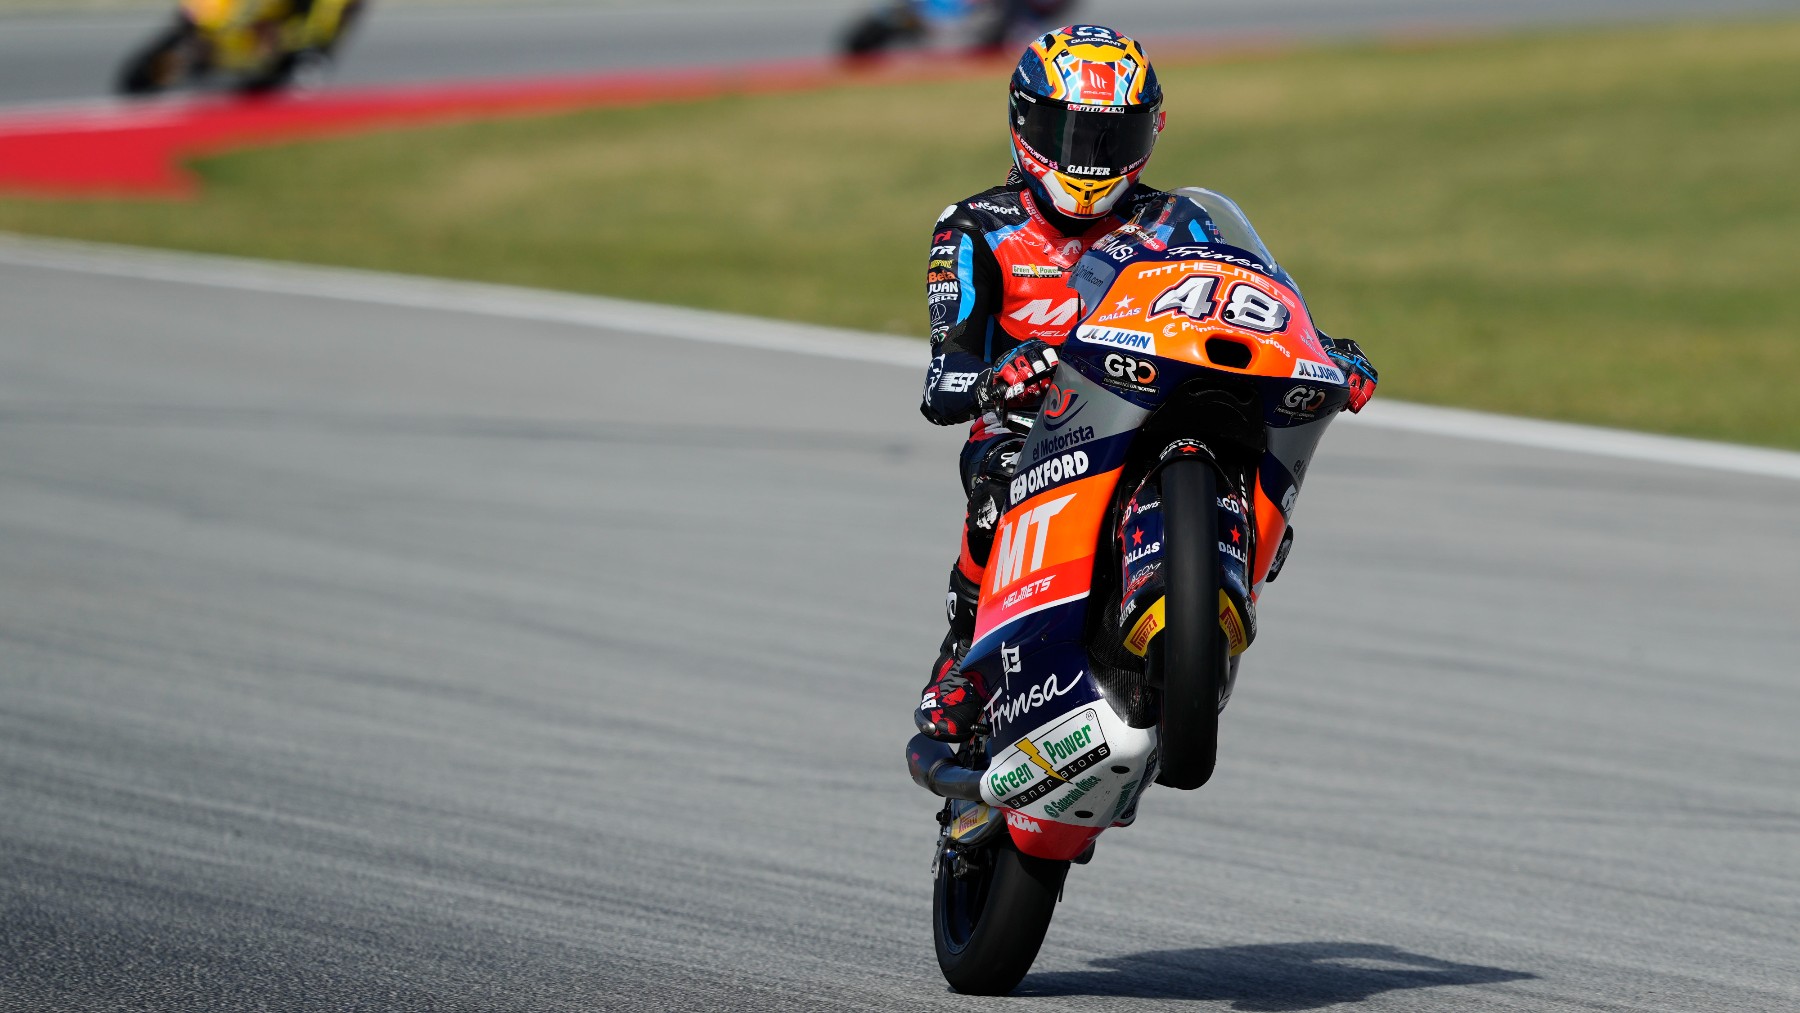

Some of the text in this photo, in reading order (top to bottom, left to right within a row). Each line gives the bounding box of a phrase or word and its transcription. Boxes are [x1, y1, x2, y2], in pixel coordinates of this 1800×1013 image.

[1071, 37, 1121, 47] QUADRANT
[1067, 164, 1110, 175] GALFER
[929, 270, 956, 283] Beta
[1165, 246, 1273, 276] Frinsa
[1097, 307, 1142, 322] DALLAS
[1147, 274, 1291, 334] 48
[1041, 425, 1095, 457] Motorista
[1027, 450, 1089, 494] OXFORD
[992, 493, 1077, 596] MT
[1001, 575, 1056, 611] HELMETS
[1130, 613, 1158, 651] PIRELLI
[984, 670, 1083, 738] Frinsa
[990, 724, 1092, 797] Green Power
[1010, 746, 1108, 809] generators
[1007, 811, 1043, 834] KTM
